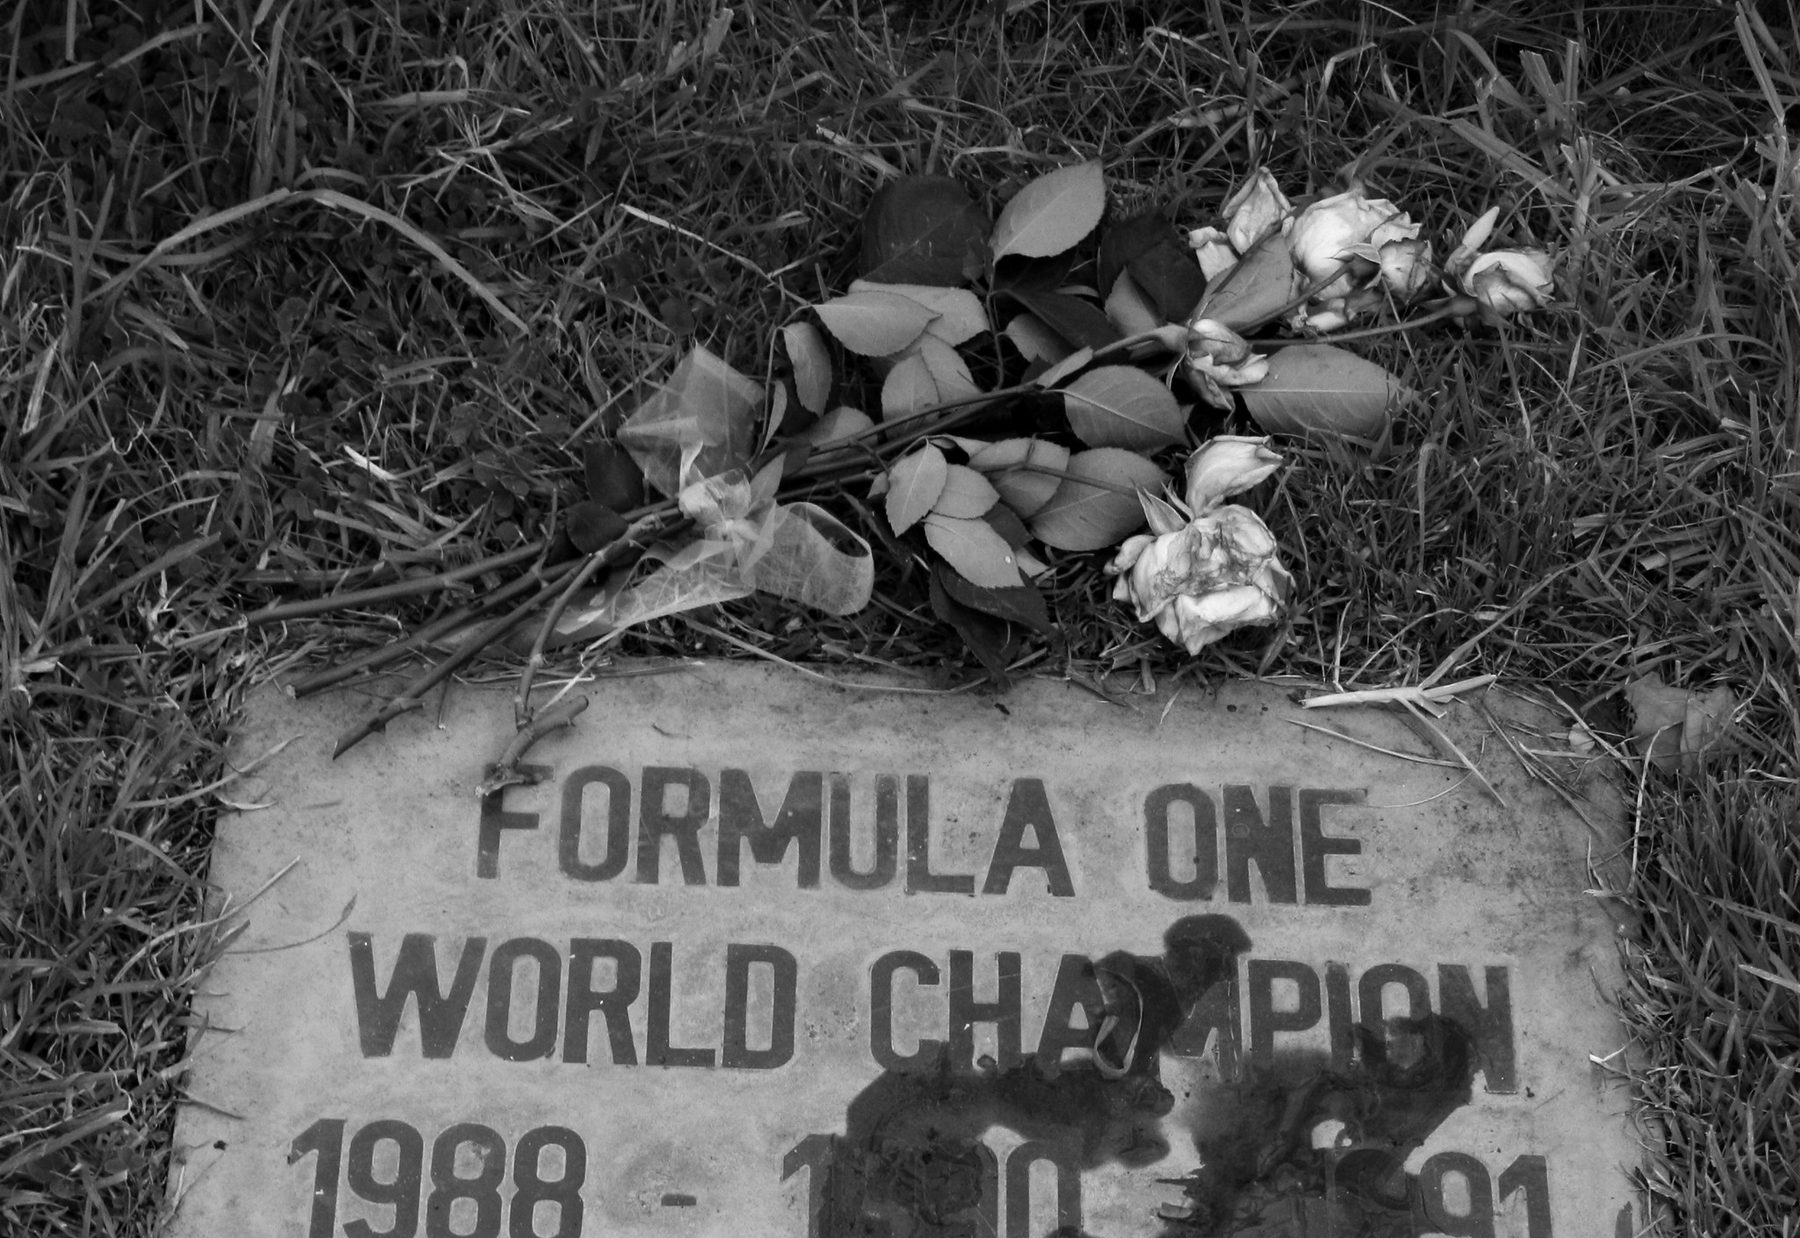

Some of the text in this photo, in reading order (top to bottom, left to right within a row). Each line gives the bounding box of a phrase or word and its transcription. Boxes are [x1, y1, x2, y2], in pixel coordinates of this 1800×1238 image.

[477, 763, 1373, 907] FORMULA ONE
[347, 931, 798, 1070] WORLD
